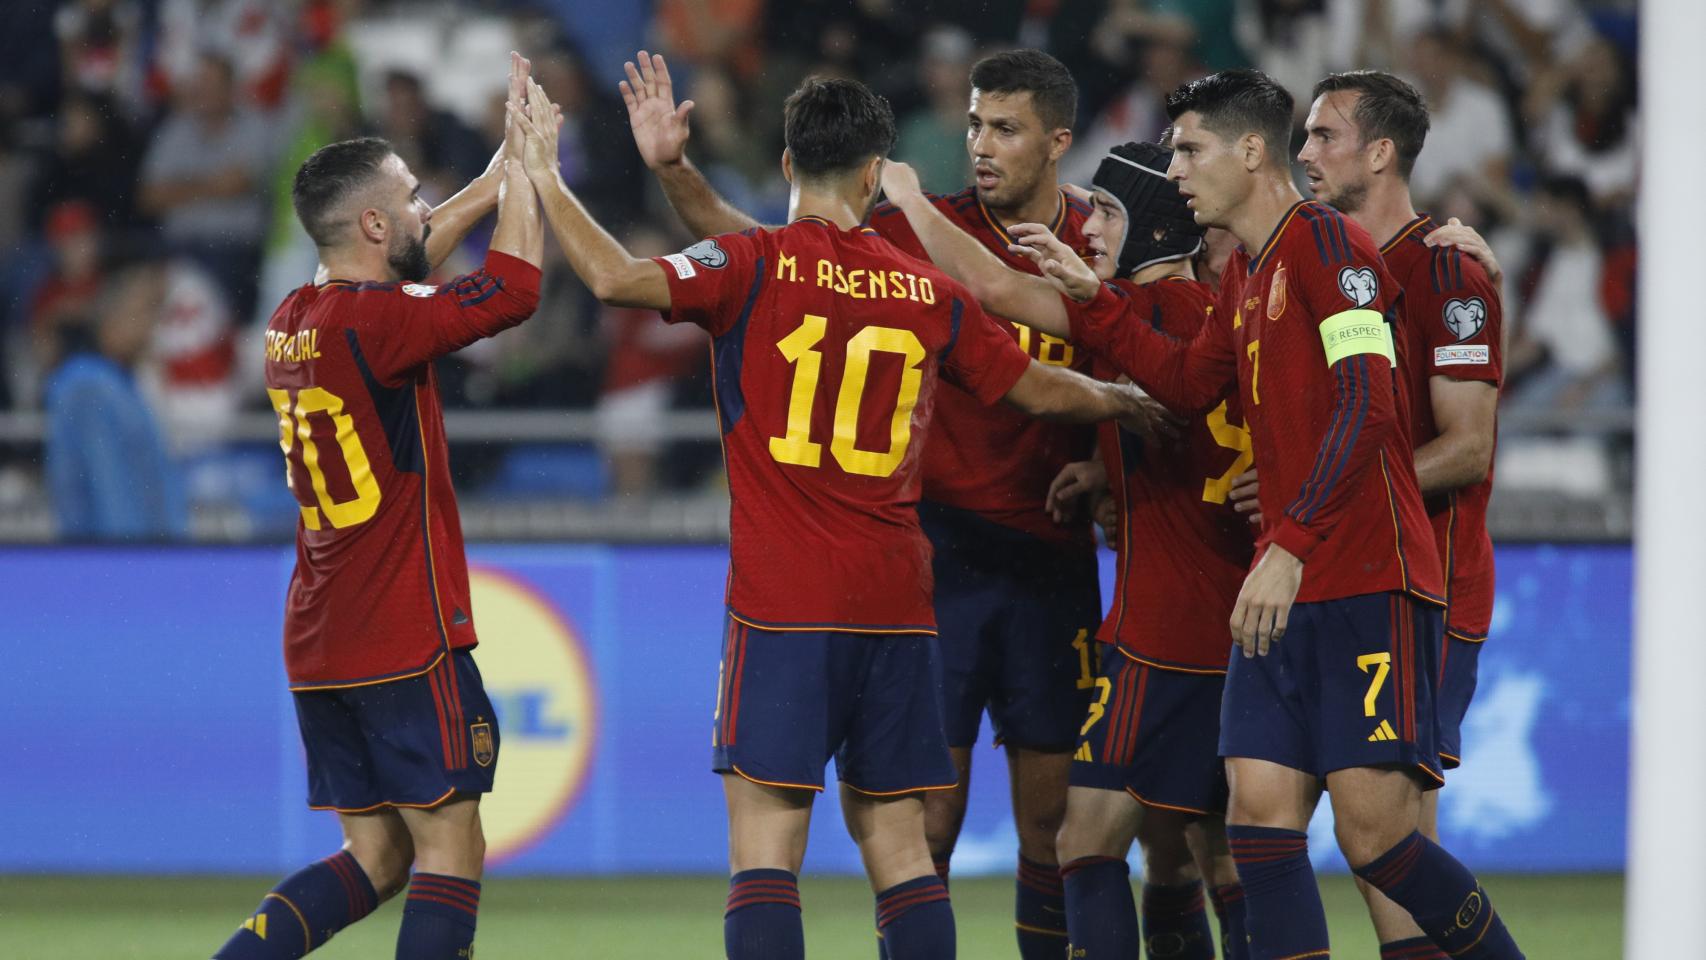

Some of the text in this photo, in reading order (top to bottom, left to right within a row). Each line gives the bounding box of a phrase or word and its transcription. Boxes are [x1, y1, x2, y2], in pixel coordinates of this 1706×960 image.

[777, 250, 935, 305] M. ASENSIO
[1339, 326, 1381, 340] RESPECT
[1435, 350, 1488, 360] FOUNDATION
[768, 313, 927, 478] 10
[1247, 339, 1260, 406] 7
[1202, 399, 1254, 505] 9
[1356, 651, 1391, 717] 7
